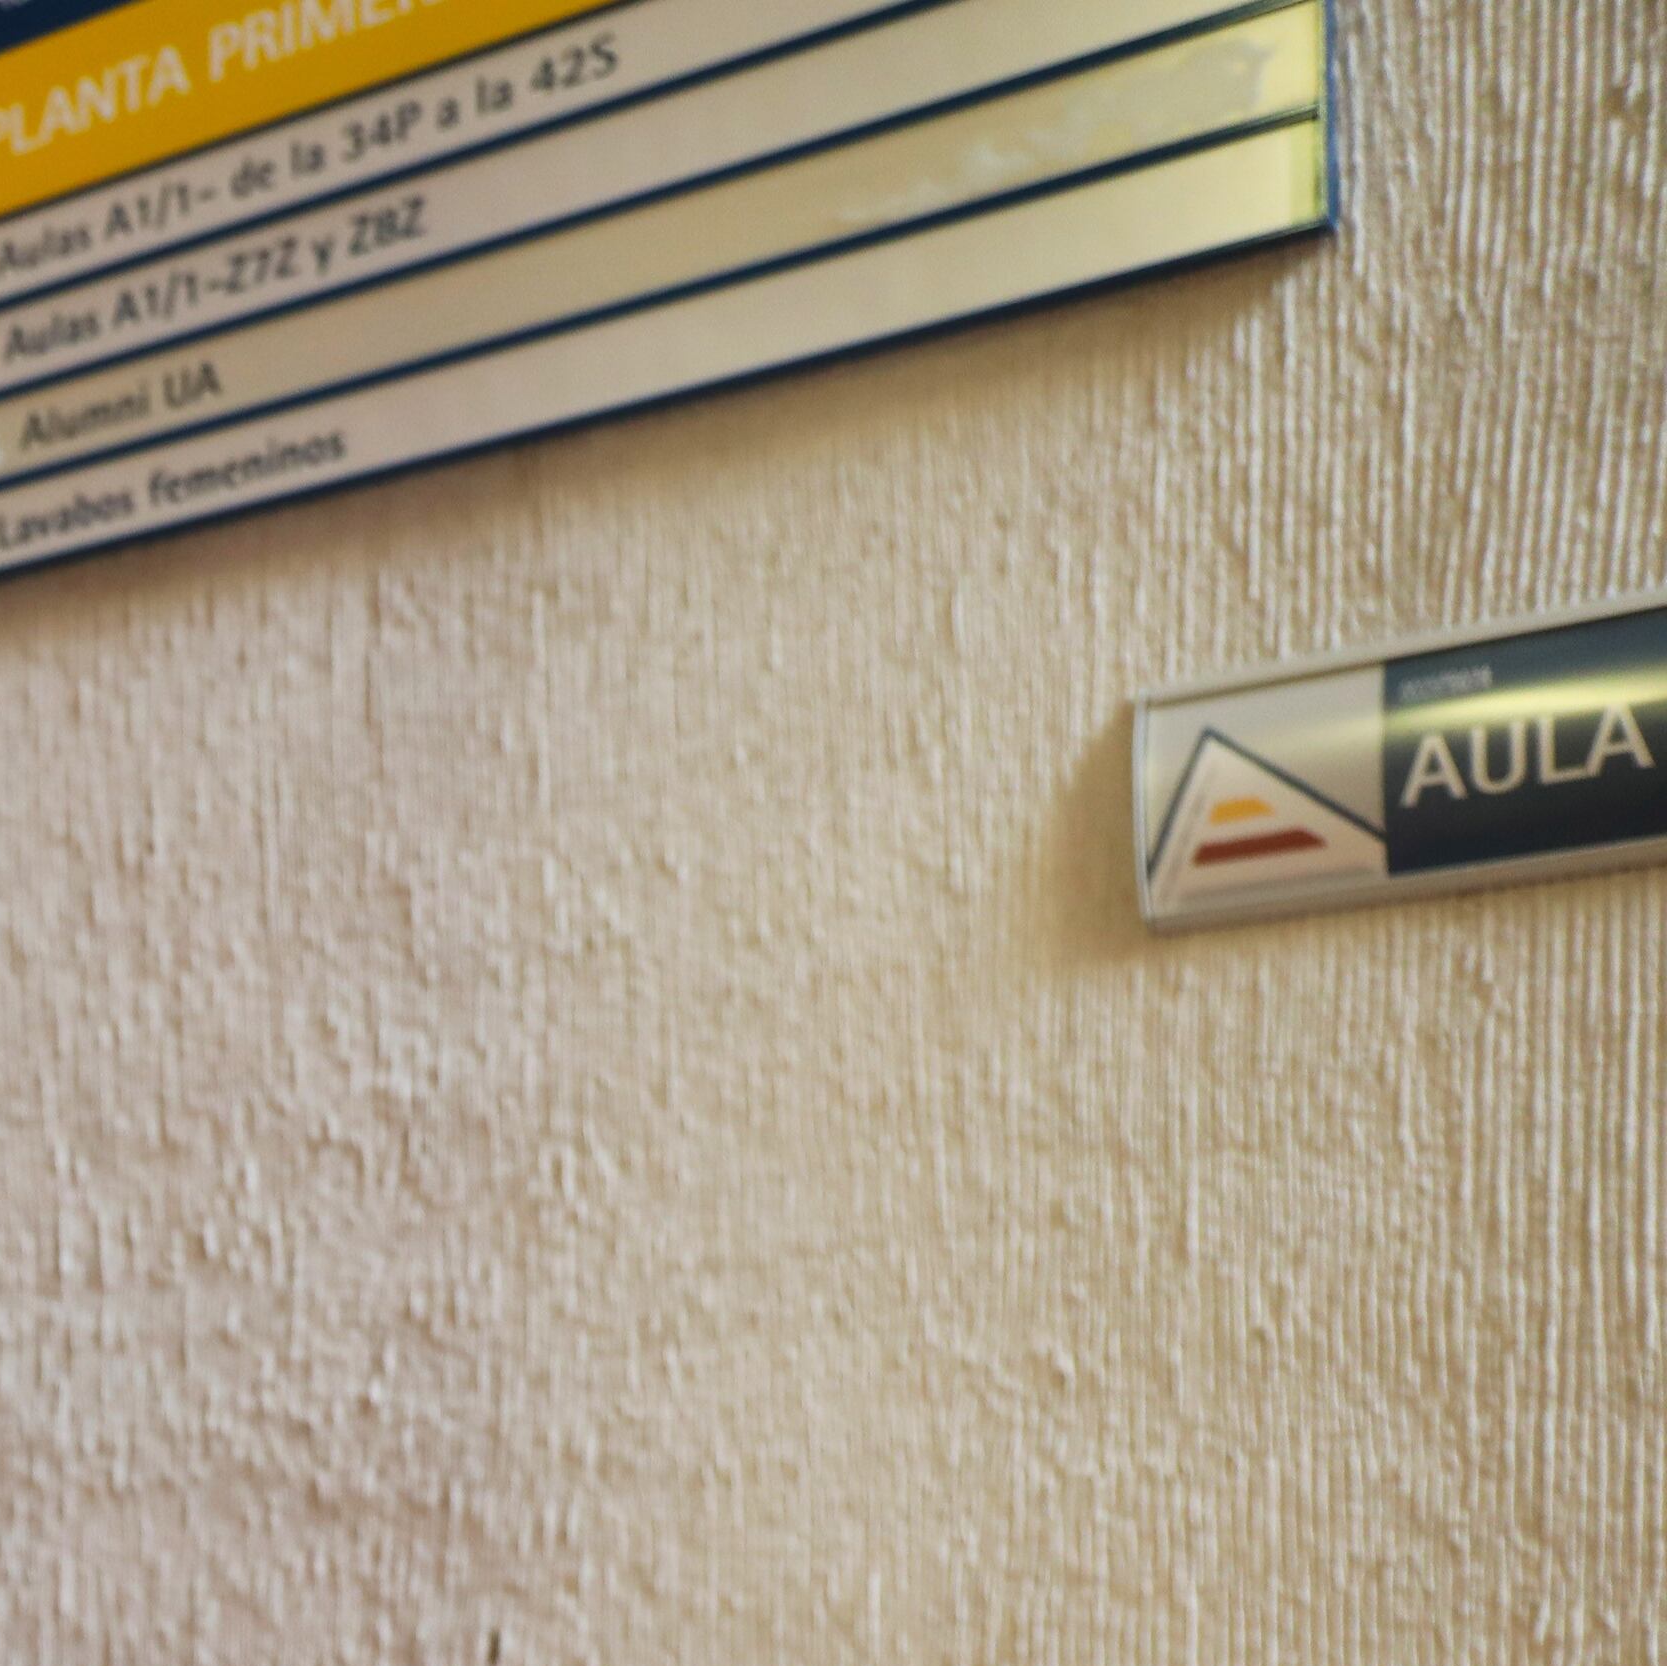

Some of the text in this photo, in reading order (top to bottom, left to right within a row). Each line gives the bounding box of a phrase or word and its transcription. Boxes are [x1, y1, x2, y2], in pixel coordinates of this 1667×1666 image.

[230, 157, 275, 199] de
[289, 140, 323, 179] la
[341, 99, 421, 162] 34P
[436, 97, 459, 129] a
[475, 73, 513, 116] la
[530, 31, 617, 93] 42S
[4, 309, 100, 363] Aulas
[312, 233, 335, 276] y
[20, 359, 223, 450] Alumni UA
[149, 431, 346, 508] femeninos
[1399, 700, 1656, 808] AULA
